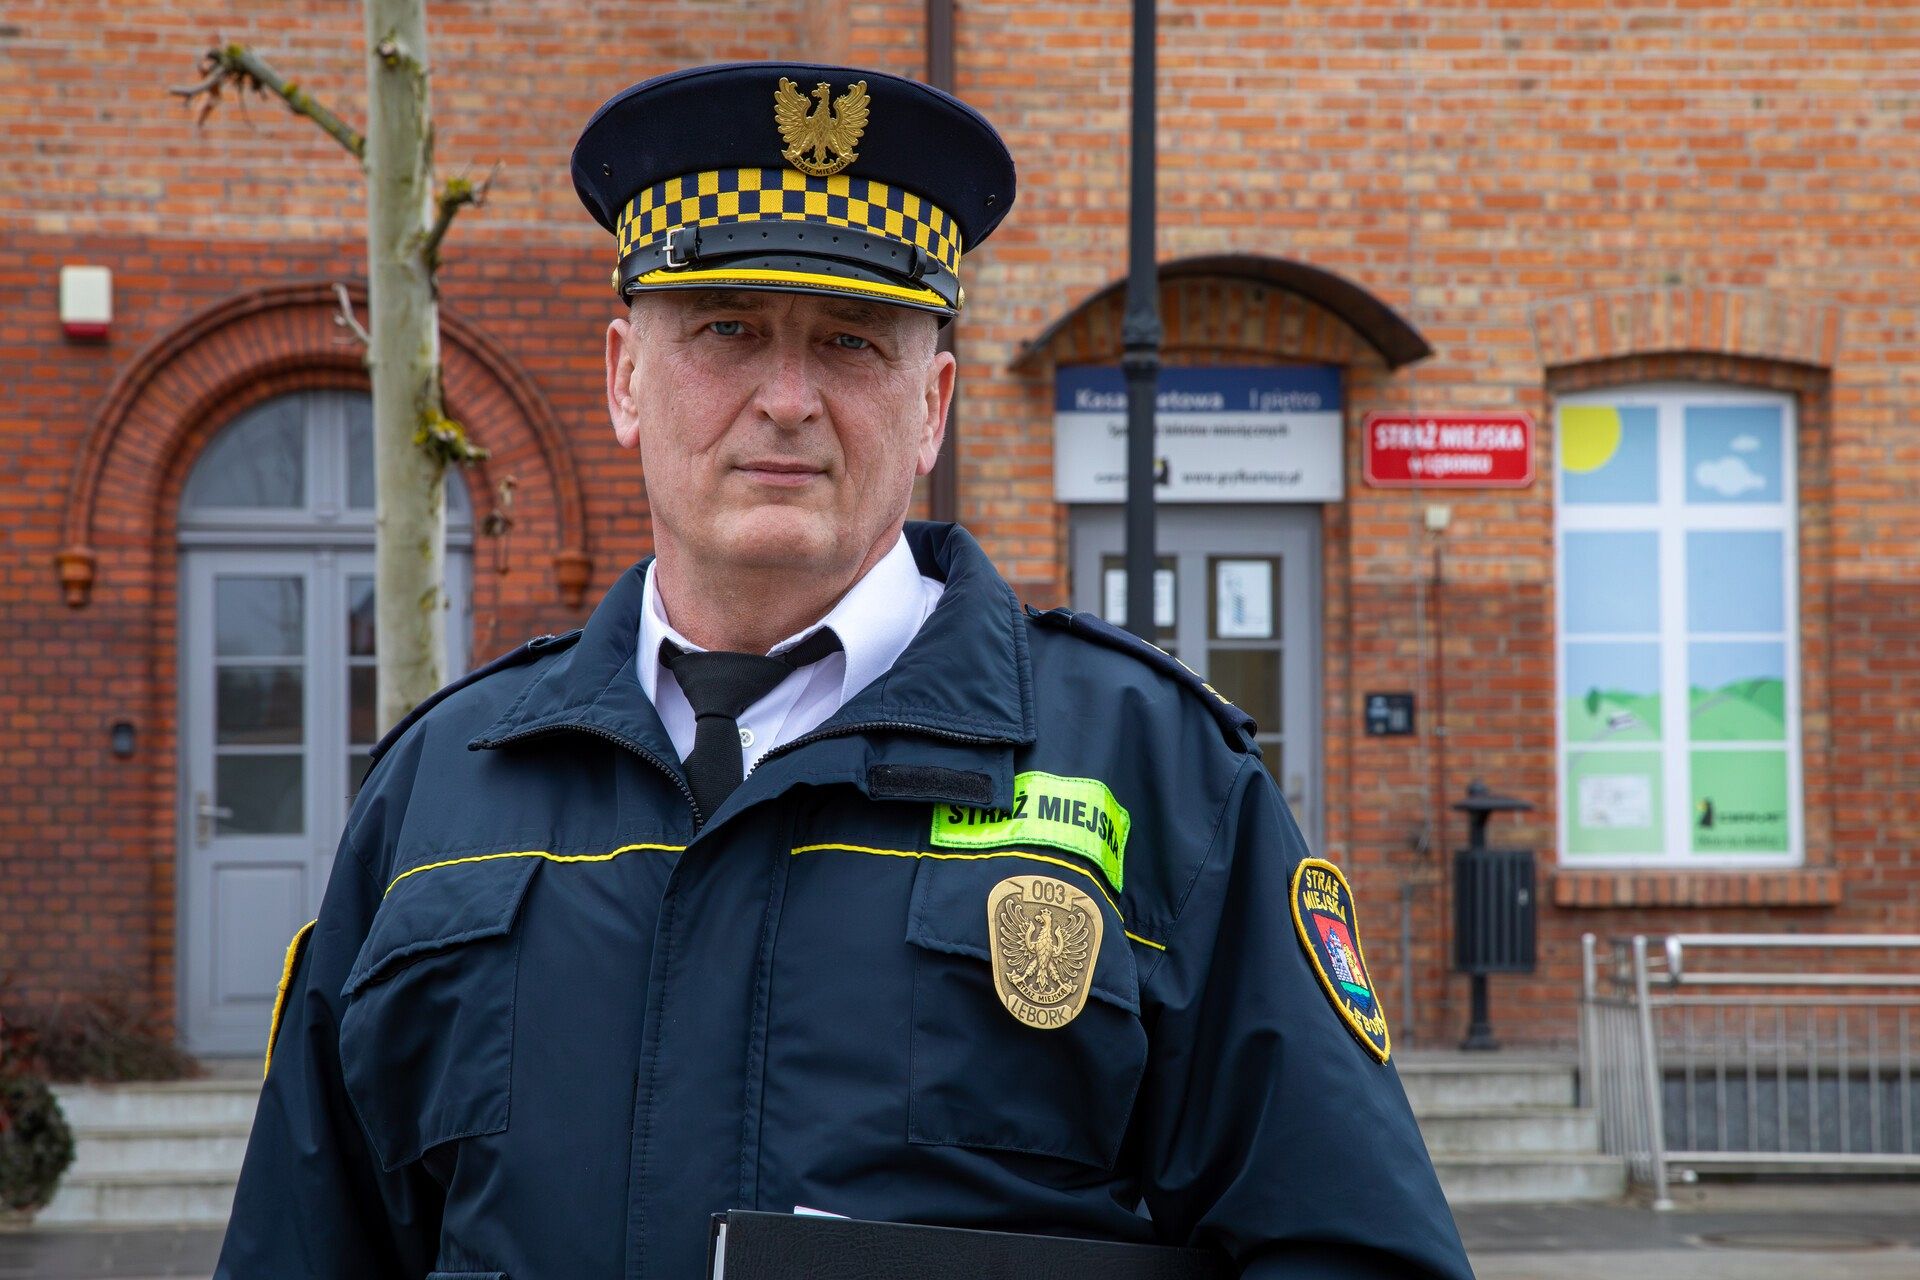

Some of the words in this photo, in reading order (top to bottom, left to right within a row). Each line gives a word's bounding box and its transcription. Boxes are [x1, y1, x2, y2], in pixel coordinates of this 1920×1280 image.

[1074, 389, 1128, 409] Kasa
[1375, 420, 1437, 450] STRAŻ
[1438, 424, 1524, 450] MIEJSKA
[1038, 795, 1119, 859] MIEJSKA
[1032, 879, 1066, 905] 003
[1302, 890, 1347, 925] MIEJSKA
